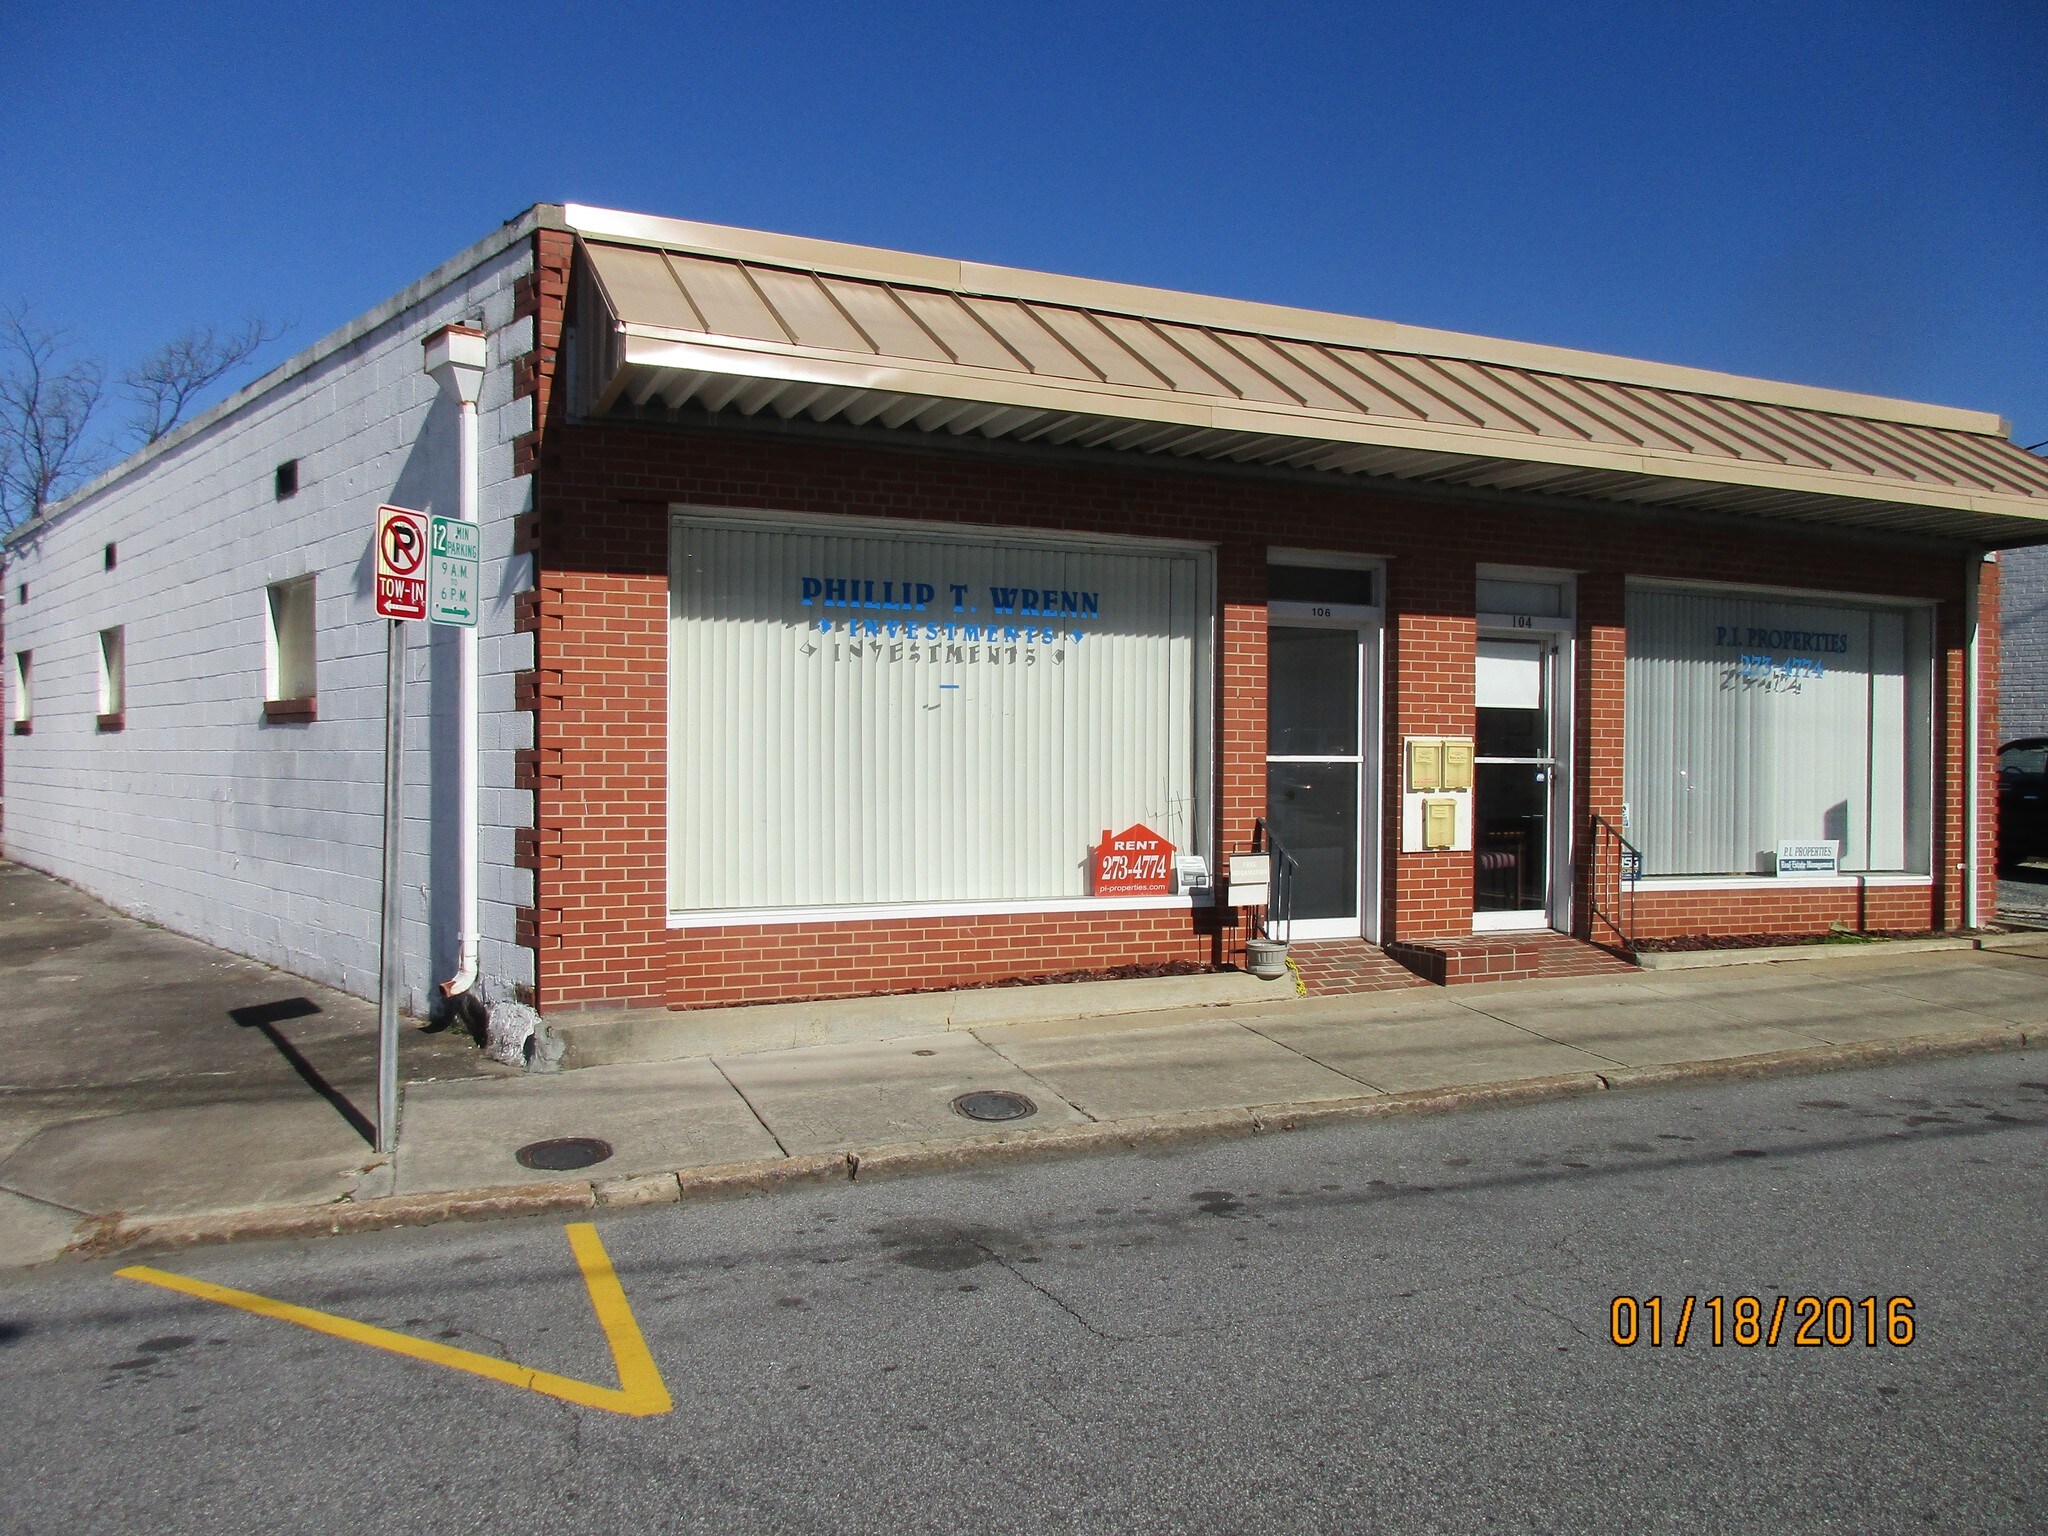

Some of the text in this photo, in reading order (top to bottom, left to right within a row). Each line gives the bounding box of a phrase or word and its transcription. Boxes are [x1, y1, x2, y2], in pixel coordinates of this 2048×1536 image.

[433, 523, 470, 551] 12 MIN
[447, 541, 477, 559] PARKING
[442, 562, 448, 575] 9
[379, 577, 424, 601] TOW-IN
[451, 578, 458, 587] TO
[441, 587, 447, 600] 6
[801, 577, 1099, 618] PHILLIP T. WRENN
[1311, 607, 1331, 618] 106
[1512, 615, 1533, 629] 104
[849, 618, 1054, 645] INVESTMENTS
[1747, 627, 1848, 654] PROPERTIES
[1740, 653, 1824, 680] 273-4774
[1114, 840, 1159, 851] RENT
[1794, 846, 1832, 857] PROPERTIES
[1101, 854, 1167, 880] 273-4774
[1100, 884, 1166, 893] pi-properties.com
